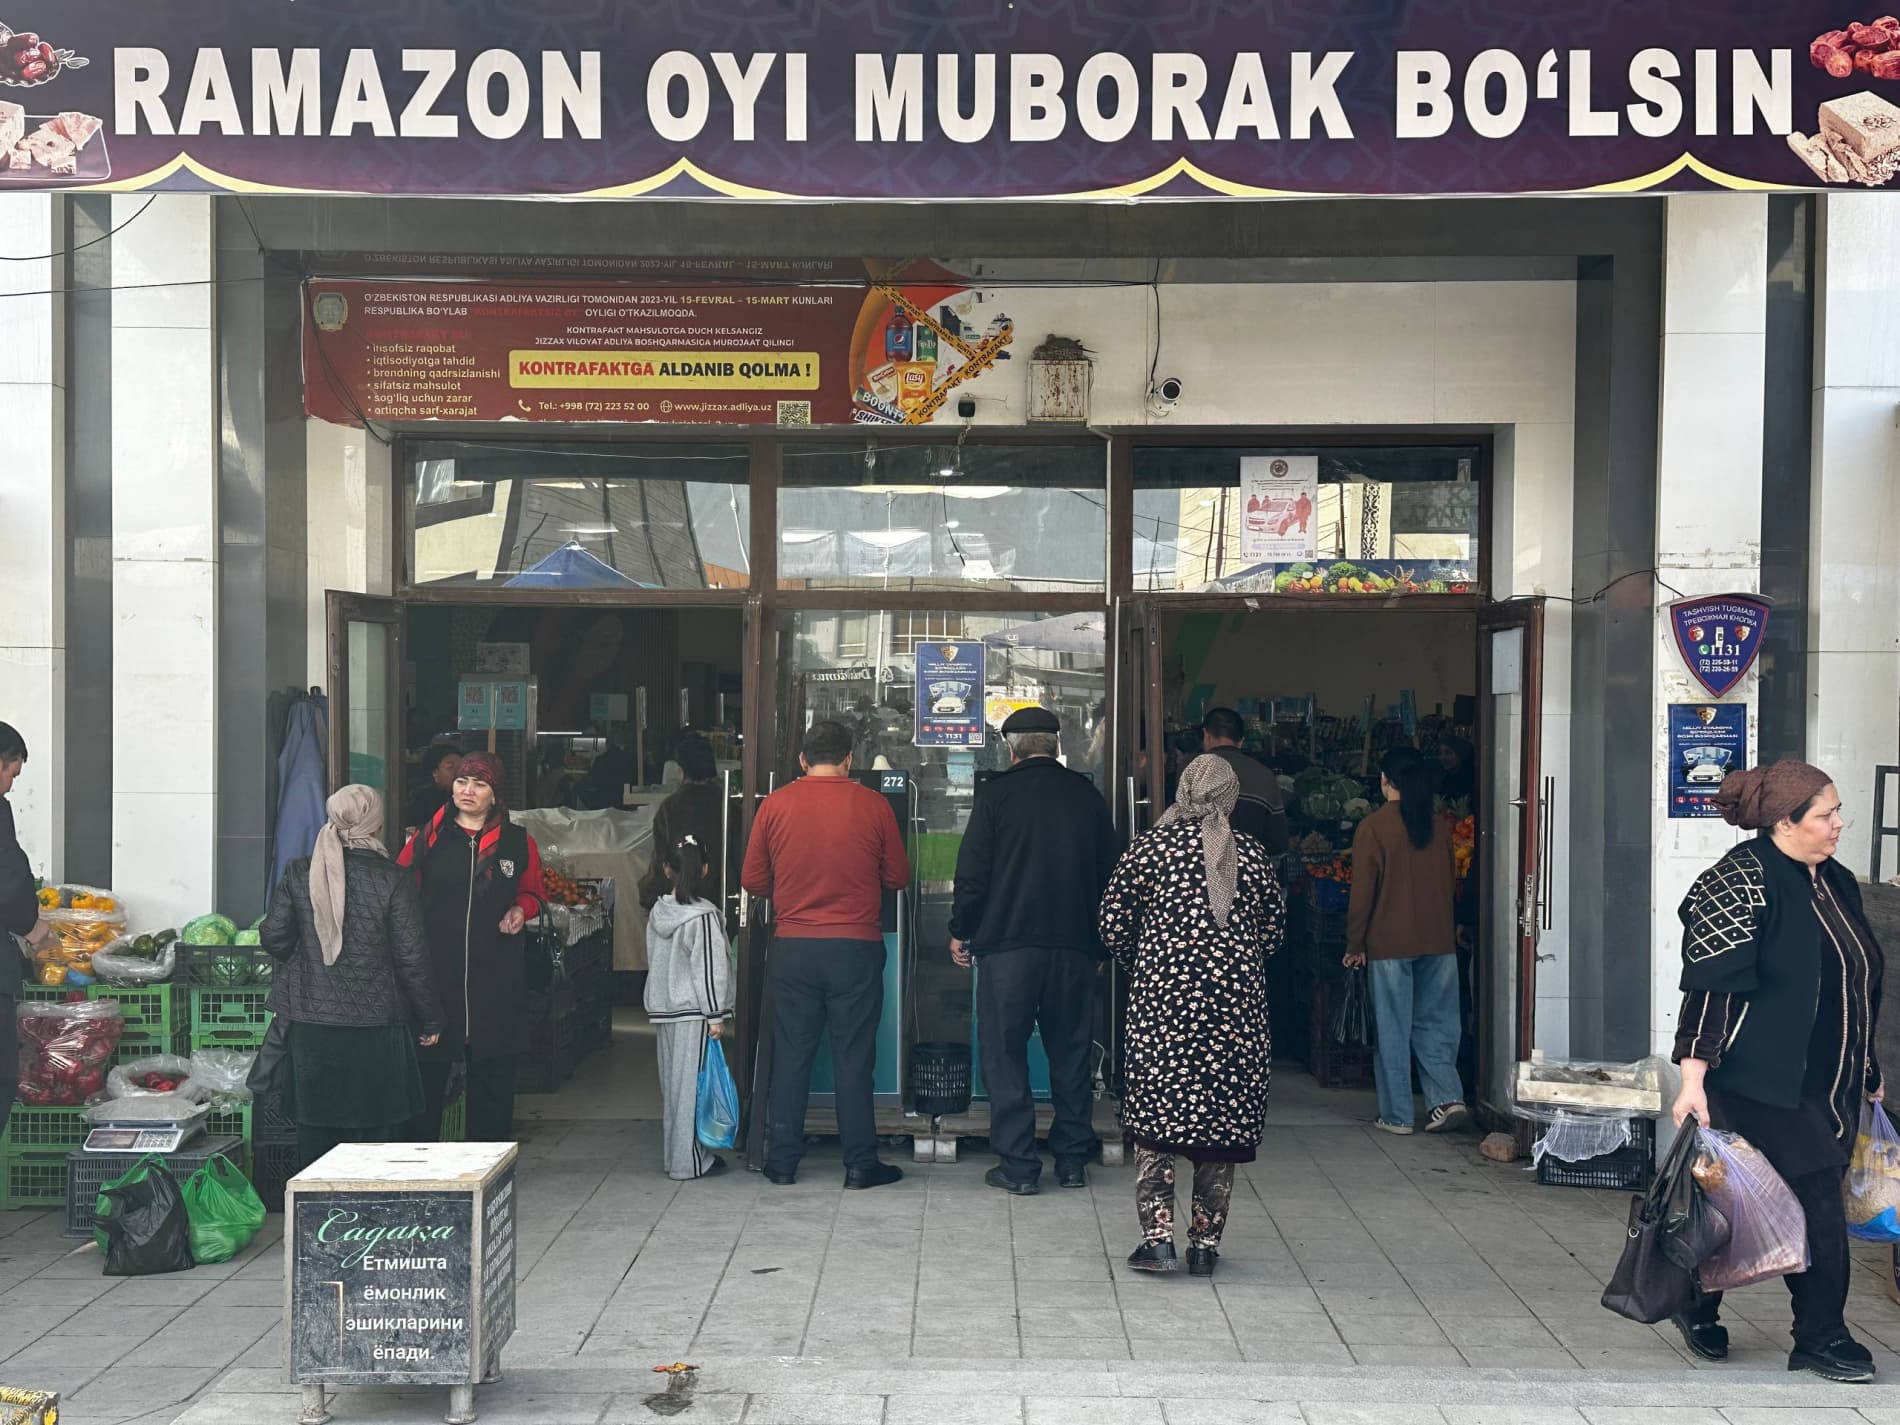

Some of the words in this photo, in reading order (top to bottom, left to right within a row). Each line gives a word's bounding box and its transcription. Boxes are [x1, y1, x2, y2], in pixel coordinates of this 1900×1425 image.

[112, 47, 602, 140] RAMAZON
[645, 51, 807, 142] OYI
[855, 51, 1355, 143] MUBORAK
[1396, 48, 1793, 139] BO‘LSIN
[429, 294, 498, 303] RESPUBLIKASI
[499, 295, 533, 303] ADLIYA
[534, 295, 580, 304] VAZIRLIGI
[582, 295, 638, 304] TOMONIDAN
[640, 296, 678, 304] 2023-YIL
[680, 296, 735, 305] 15-FEVRAL
[746, 296, 790, 305] 15-MART
[792, 296, 833, 305] KUNLARI
[364, 306, 424, 315] RESPUBLIKA
[585, 309, 617, 317] OYLIGI
[566, 326, 625, 335] KONTRAFAKT
[626, 327, 687, 335] MAHSULOTGA
[688, 327, 713, 335] DUCH
[715, 327, 764, 335] KELSANGIZ
[535, 337, 565, 346] JIZZAX
[566, 338, 603, 346] VILOYAT
[604, 338, 633, 346] ADLIYA
[634, 338, 712, 347] BOSHQARMASIGA
[713, 338, 761, 346] MUROJAAT
[373, 344, 414, 353] insofsiz
[416, 344, 456, 356] raqobat
[373, 356, 441, 368] iqtisodiyotga
[443, 356, 475, 366] tahdid
[965, 336, 1009, 377] KONTRAFAKT
[428, 368, 501, 379] qadrsizlanishi
[519, 360, 655, 376] KONTRAFAKTGA
[659, 362, 735, 377] ALDANIB
[739, 362, 801, 378] QOLMA
[373, 381, 411, 390] sifatsiz
[413, 381, 462, 391] mahsulot
[411, 393, 444, 403] uchun
[446, 394, 473, 403] zarar
[374, 405, 417, 417] ortiqcha
[419, 405, 478, 417] sarf-xarajat
[559, 402, 583, 410] +998
[585, 402, 603, 411] (72)
[605, 402, 623, 410] 223
[624, 402, 636, 410] 52
[637, 402, 649, 410] 00
[674, 402, 772, 412] www.jizzax.adliya.uz
[1683, 605, 1720, 617] TASHVISH
[1722, 605, 1756, 617] TUGMASI
[1710, 644, 1740, 656] 1131
[883, 776, 904, 787] 272
[363, 1255, 447, 1271] Етмишта
[363, 1284, 447, 1301] ёмонлик
[345, 1316, 463, 1333] эшикларини
[373, 1345, 435, 1361] ёпади.
